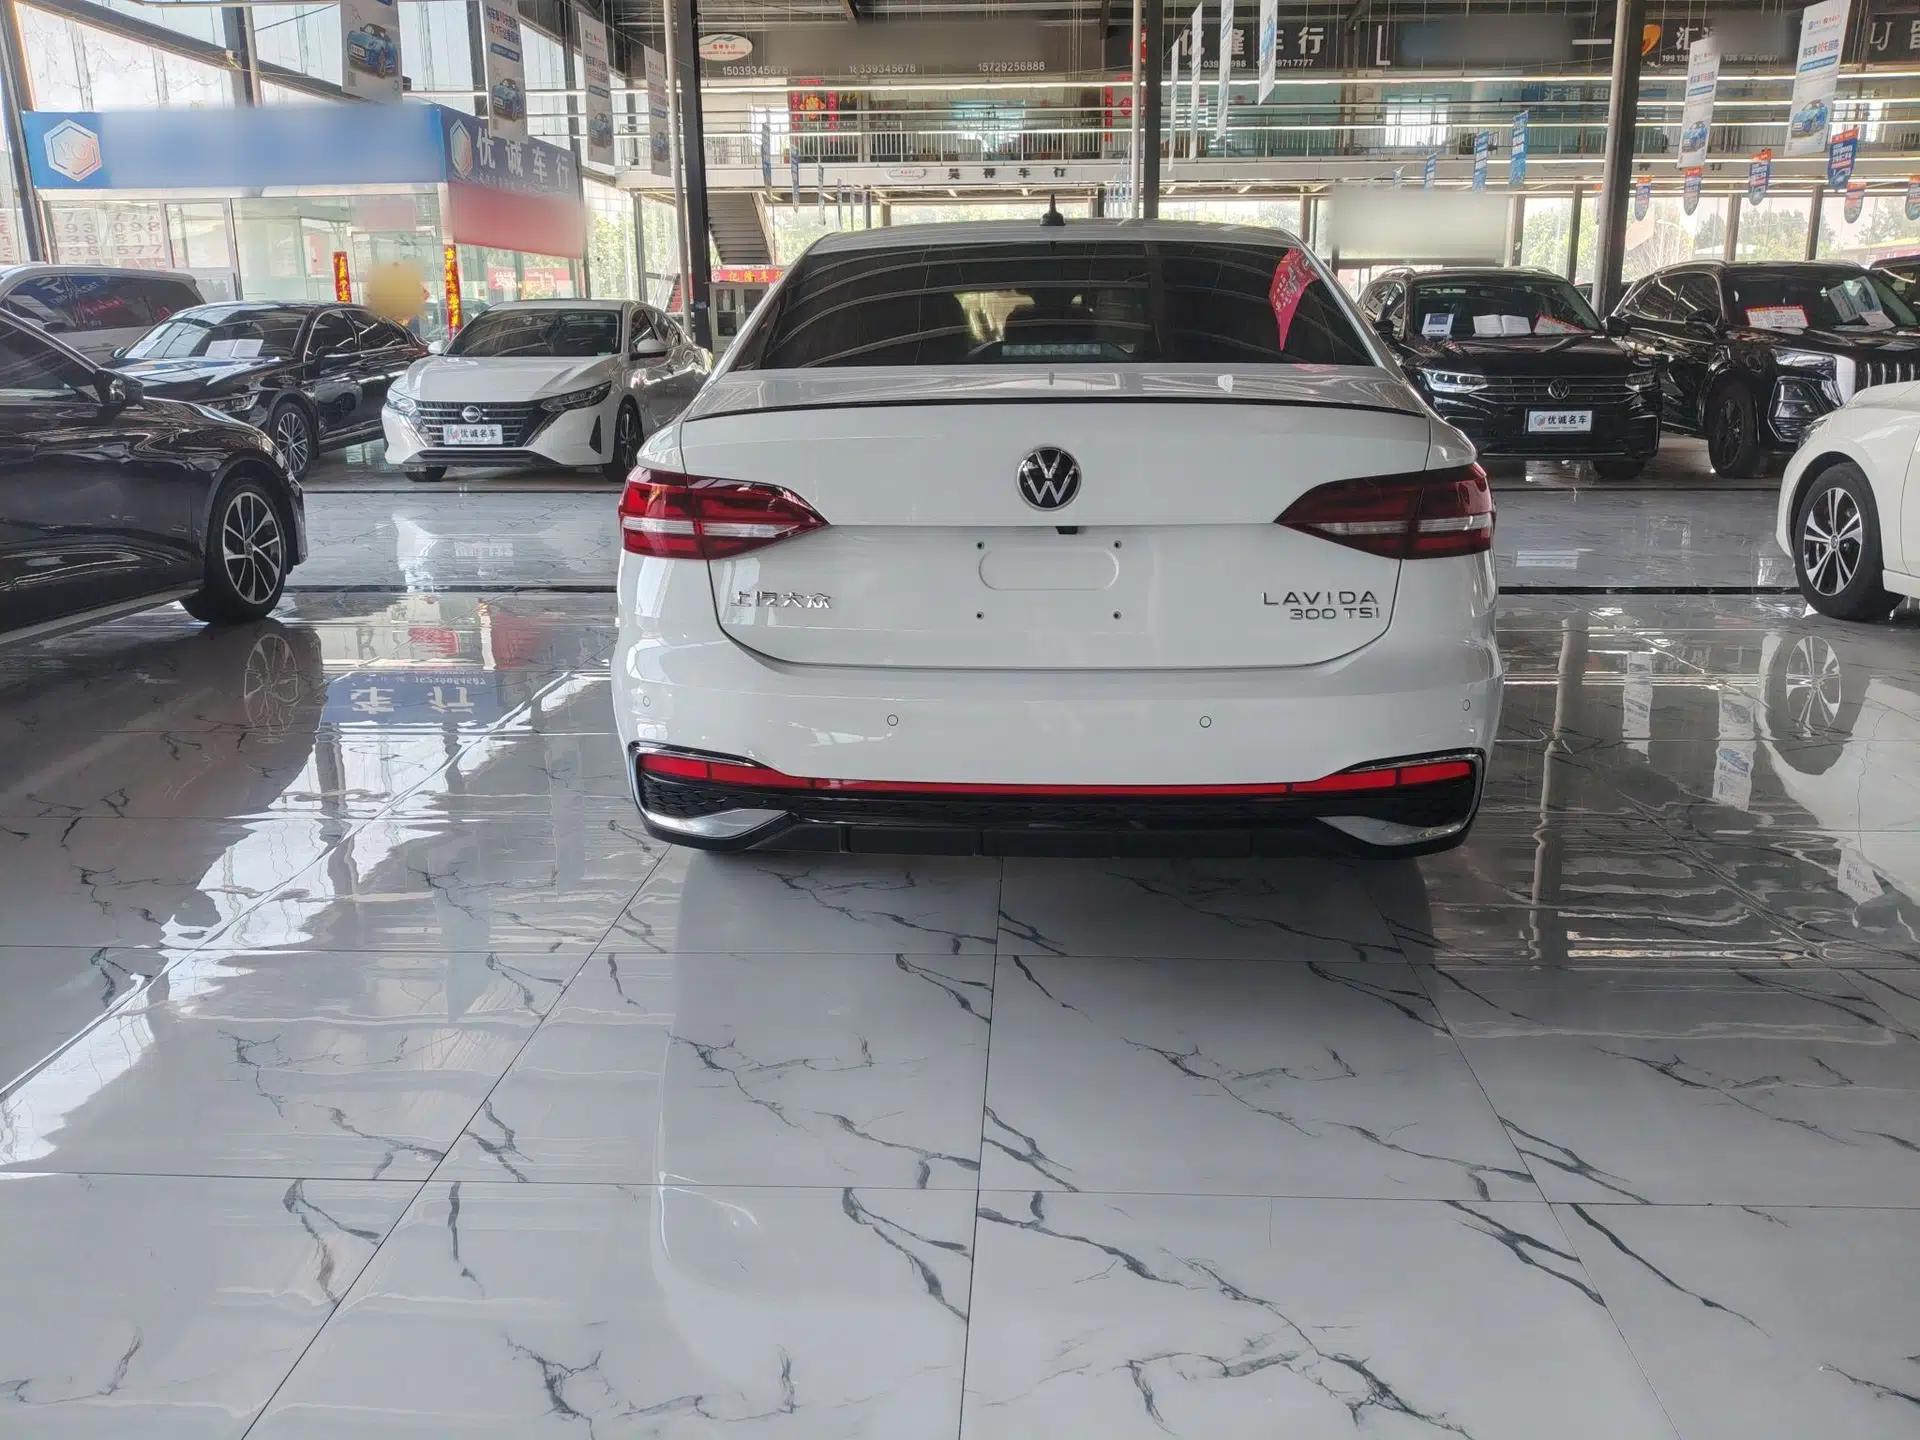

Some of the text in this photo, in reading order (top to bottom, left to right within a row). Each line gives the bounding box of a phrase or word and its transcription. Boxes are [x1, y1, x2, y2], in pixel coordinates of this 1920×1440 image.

[978, 61, 1045, 72] 15729256888
[1547, 414, 1587, 425] 优诚名车
[1262, 590, 1378, 605] LAVIDA
[1289, 607, 1380, 620] 300 TSI
